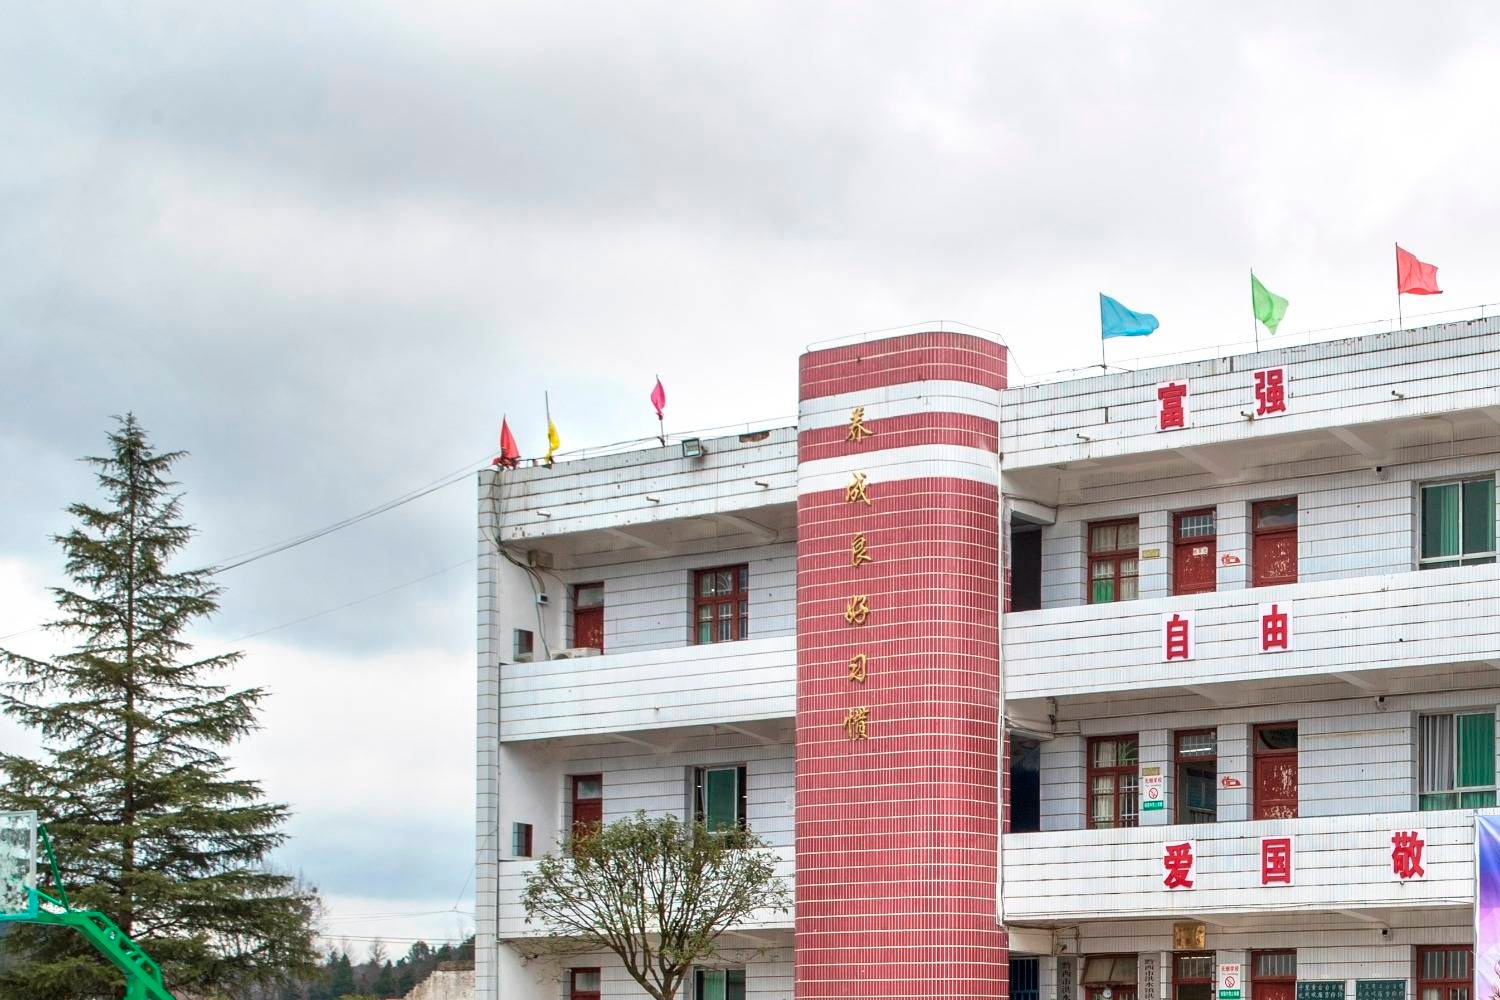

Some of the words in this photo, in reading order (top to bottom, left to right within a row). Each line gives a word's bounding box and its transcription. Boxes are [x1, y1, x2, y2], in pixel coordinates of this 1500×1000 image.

[1158, 368, 1286, 428] 富强
[842, 405, 874, 742] 养成良好习惯
[1166, 605, 1289, 659] 自由
[1391, 830, 1426, 879] 敬
